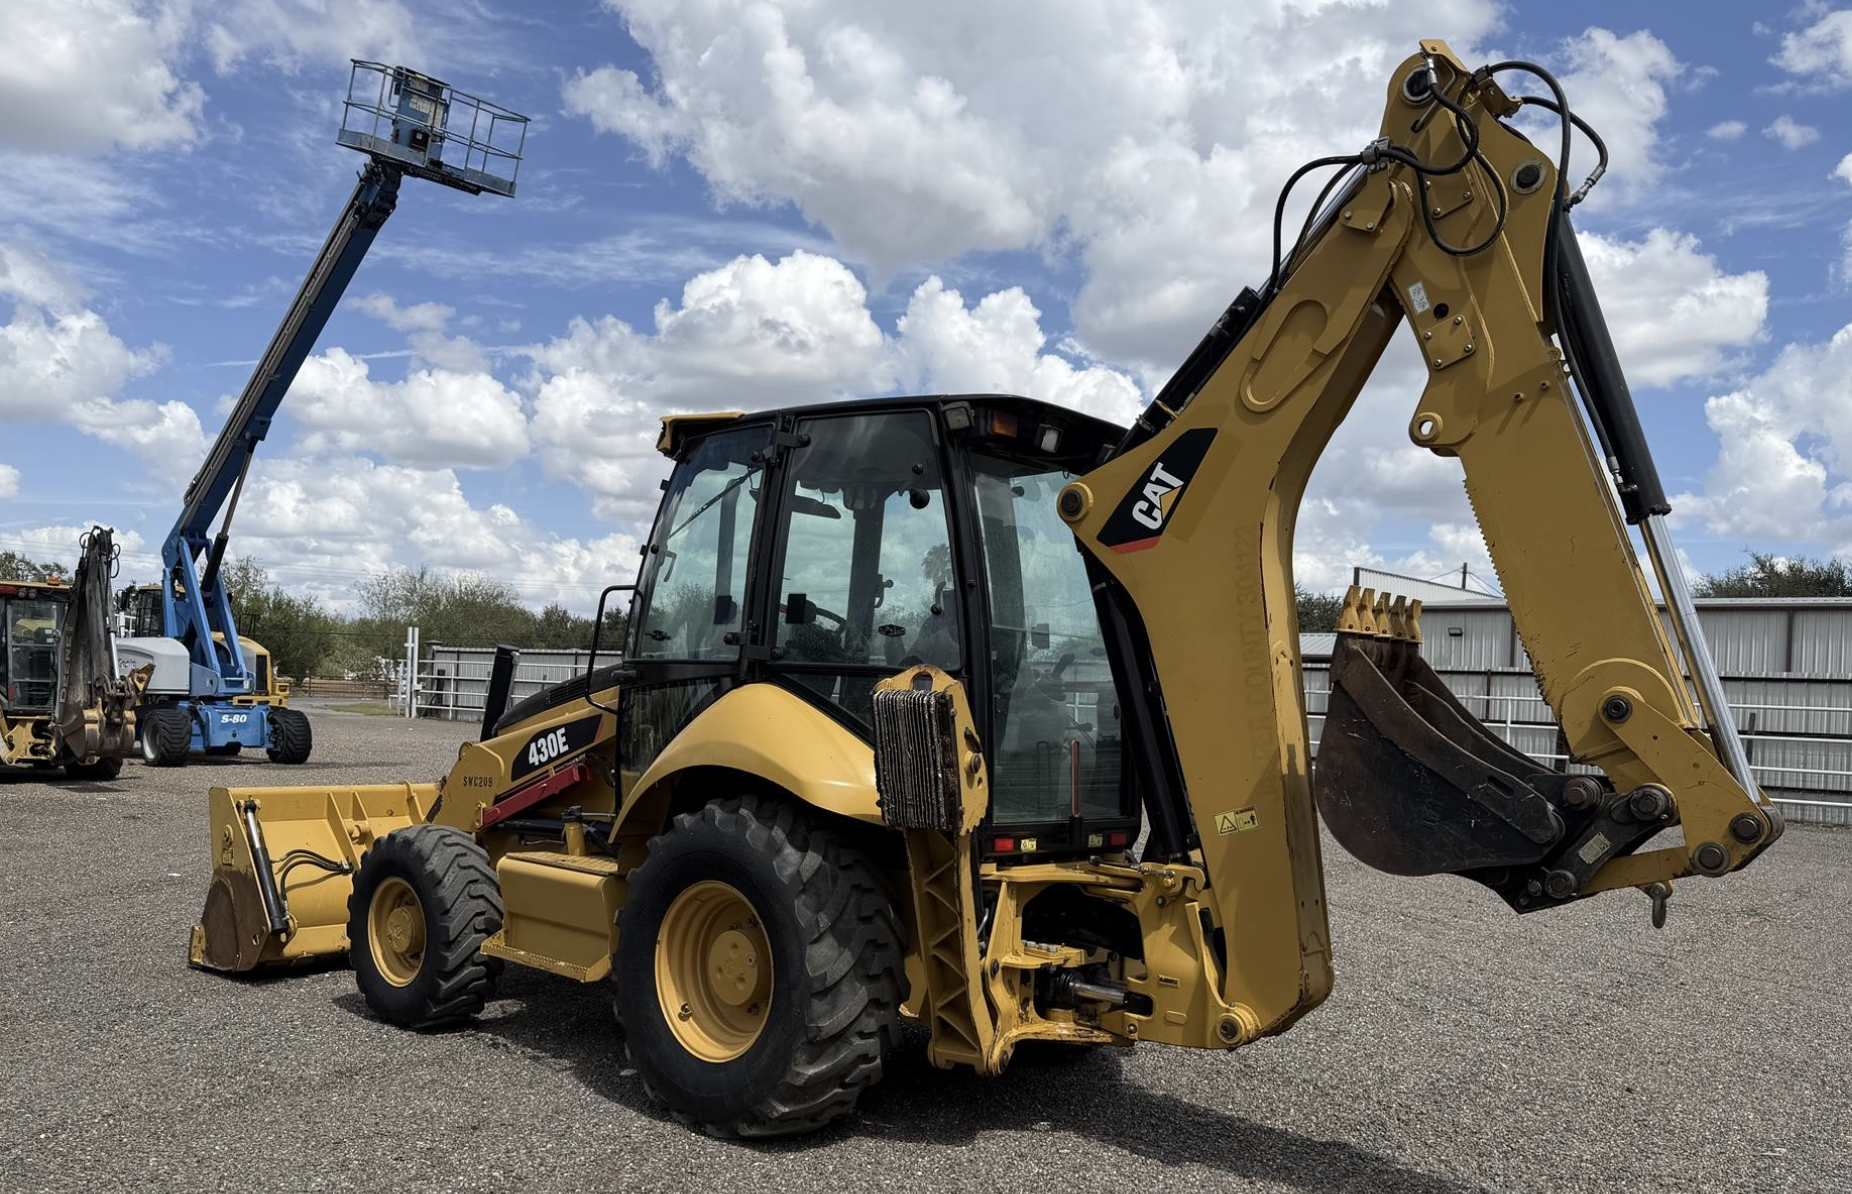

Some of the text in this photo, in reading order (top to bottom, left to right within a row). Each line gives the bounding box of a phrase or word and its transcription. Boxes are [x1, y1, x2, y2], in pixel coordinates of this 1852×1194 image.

[1132, 462, 1185, 530] CAT
[1239, 611, 1266, 705] COUNTY
[220, 714, 247, 724] S-80
[528, 727, 569, 766] 430E
[463, 777, 493, 788] SWC209
